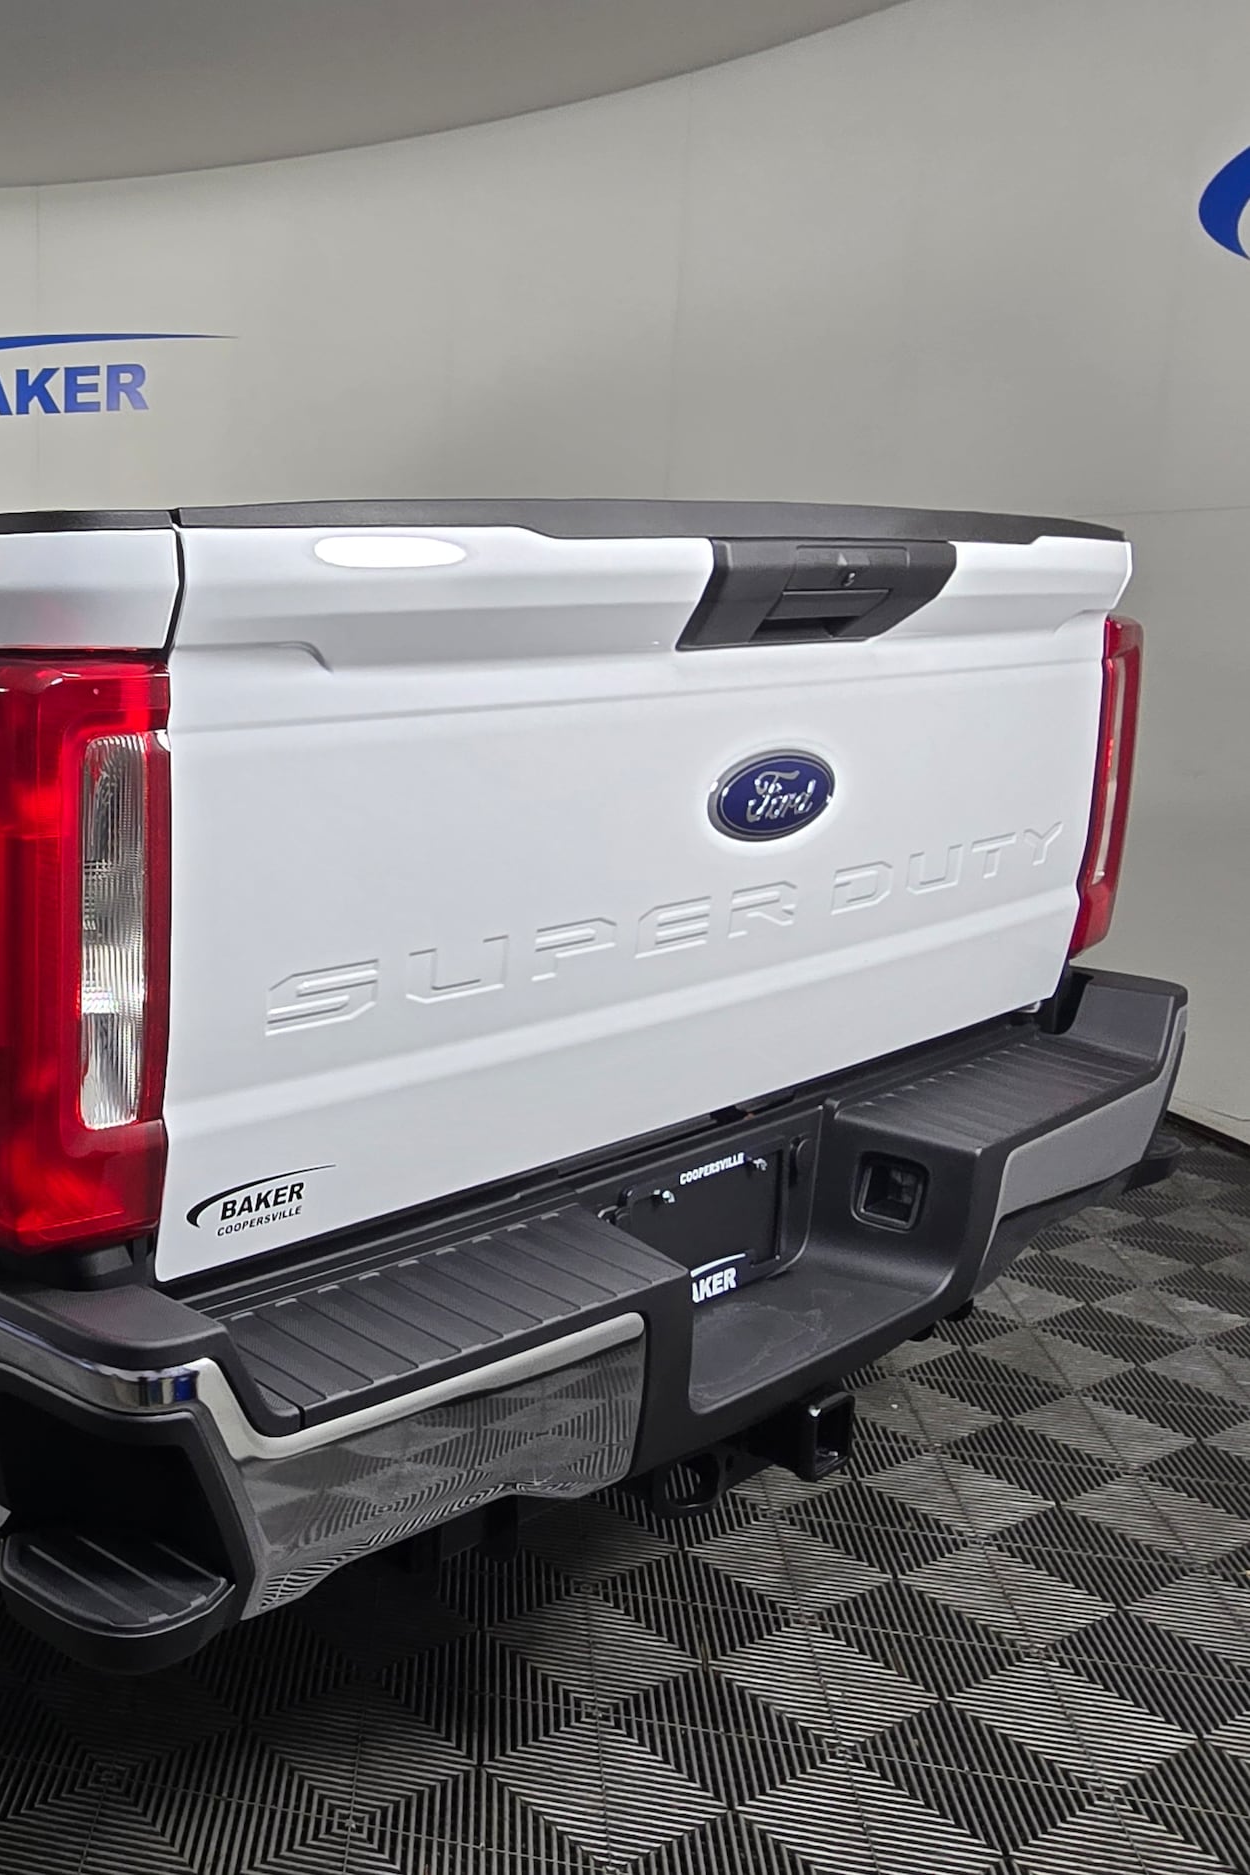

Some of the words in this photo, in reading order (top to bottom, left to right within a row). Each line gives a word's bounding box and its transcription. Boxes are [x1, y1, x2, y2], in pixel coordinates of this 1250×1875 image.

[745, 770, 817, 823] Ford
[265, 881, 798, 1036] SUPER
[830, 821, 1064, 915] DUTY
[679, 1152, 745, 1185] COOPERSVILLE
[217, 1205, 303, 1237] COOPERSVILLE
[220, 1182, 305, 1221] BAKER
